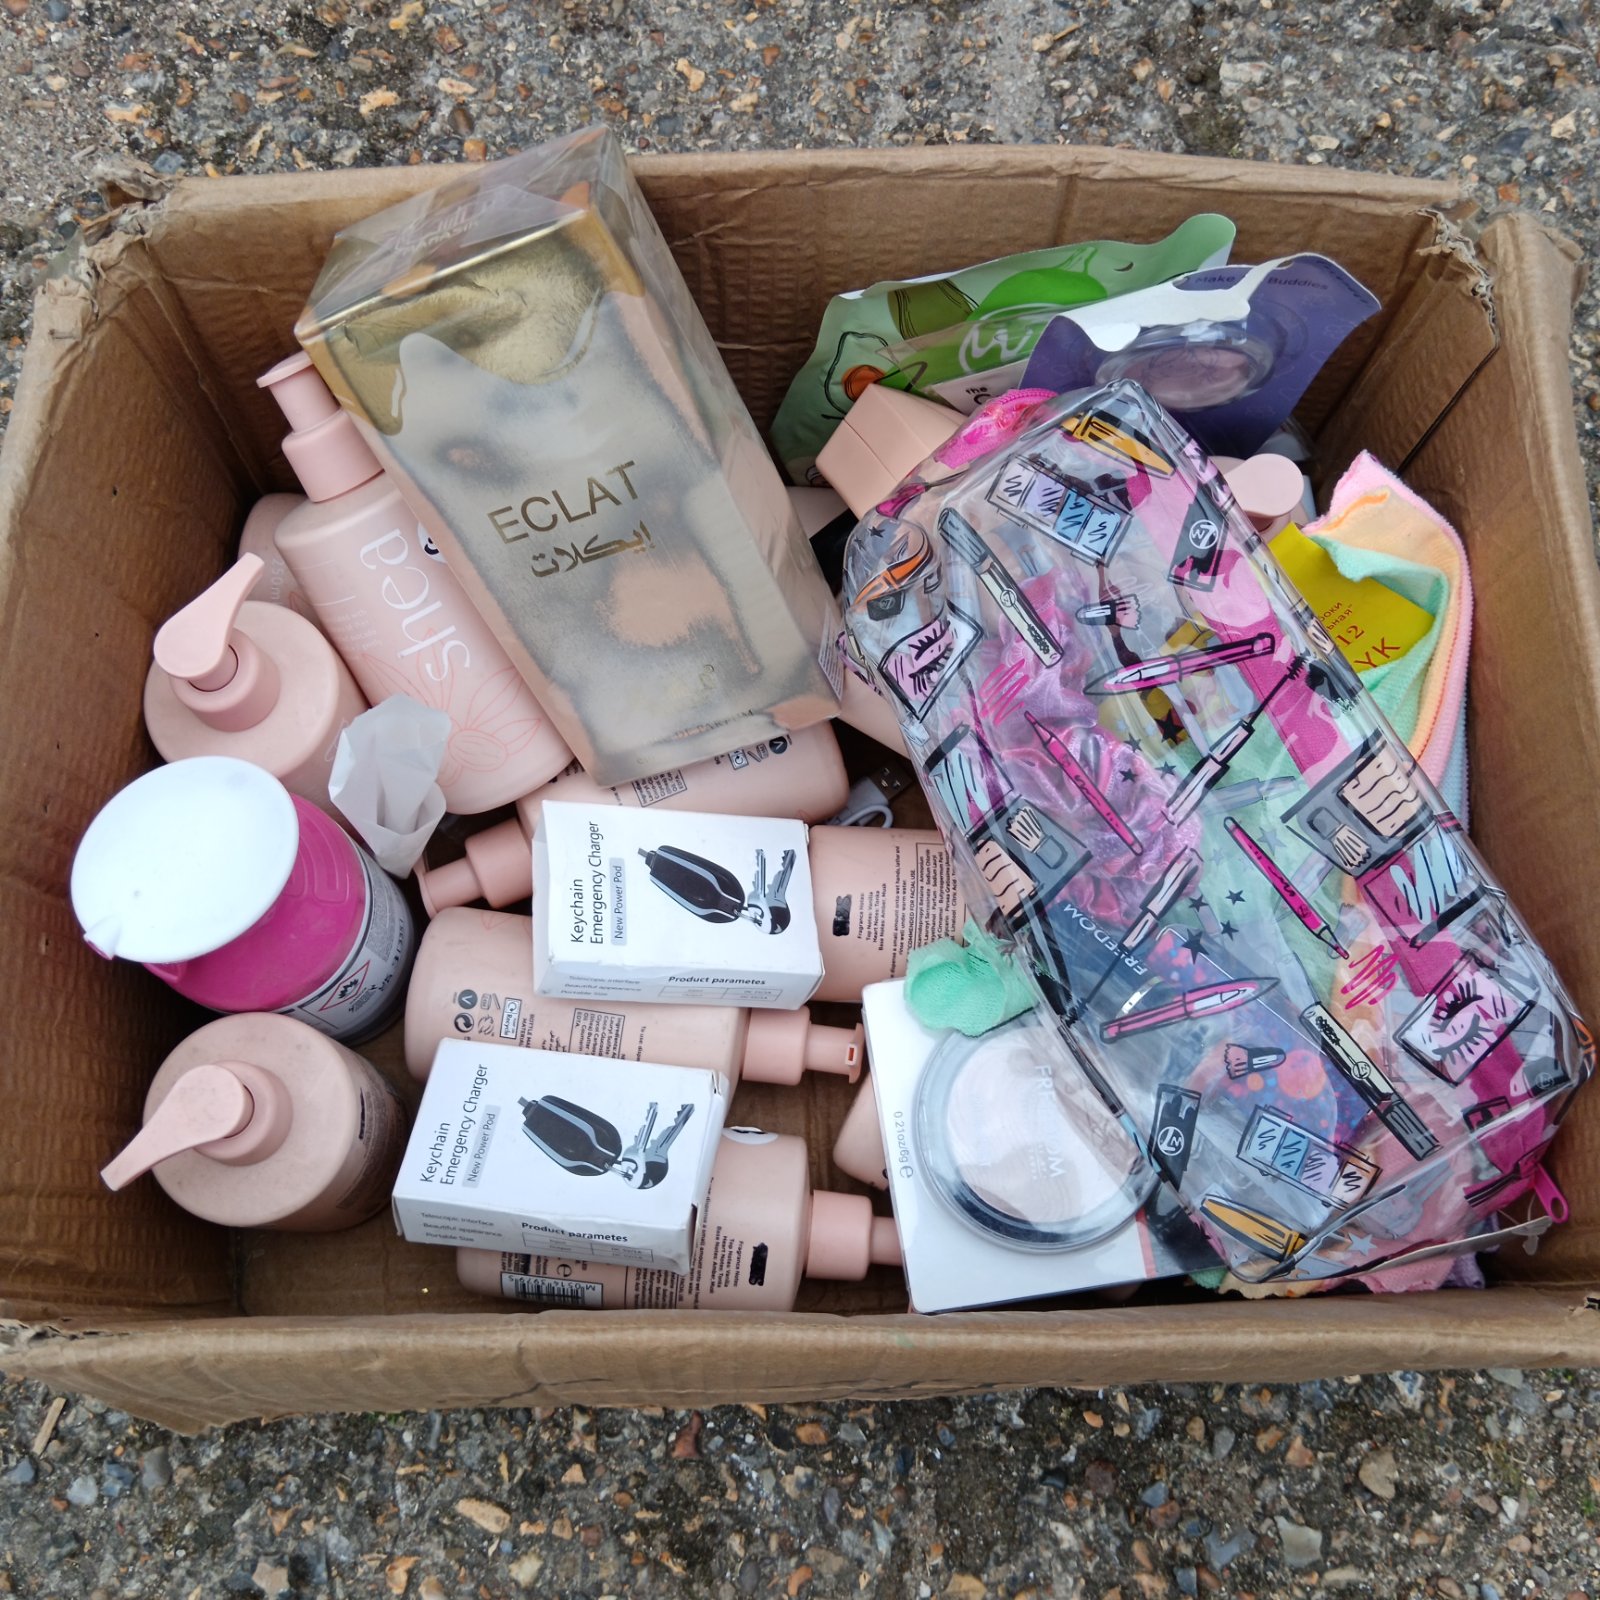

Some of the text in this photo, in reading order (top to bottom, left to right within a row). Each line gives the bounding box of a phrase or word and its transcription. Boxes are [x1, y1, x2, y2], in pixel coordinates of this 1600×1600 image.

[1267, 277, 1329, 290] Buddies
[965, 386, 988, 395] the
[487, 460, 638, 544] ECLAT
[360, 528, 470, 681] shea
[570, 879, 588, 943] Keychain
[588, 820, 607, 944] Emergency Charger
[612, 865, 624, 939] New Power Pod
[669, 975, 766, 986] Product parametes
[420, 1122, 451, 1183] Keychain
[440, 1064, 488, 1185] Emergency Charger
[467, 1113, 496, 1182] New Power Pod
[1035, 1065, 1067, 1178] FREOM
[521, 1221, 628, 1243] Product parametes
